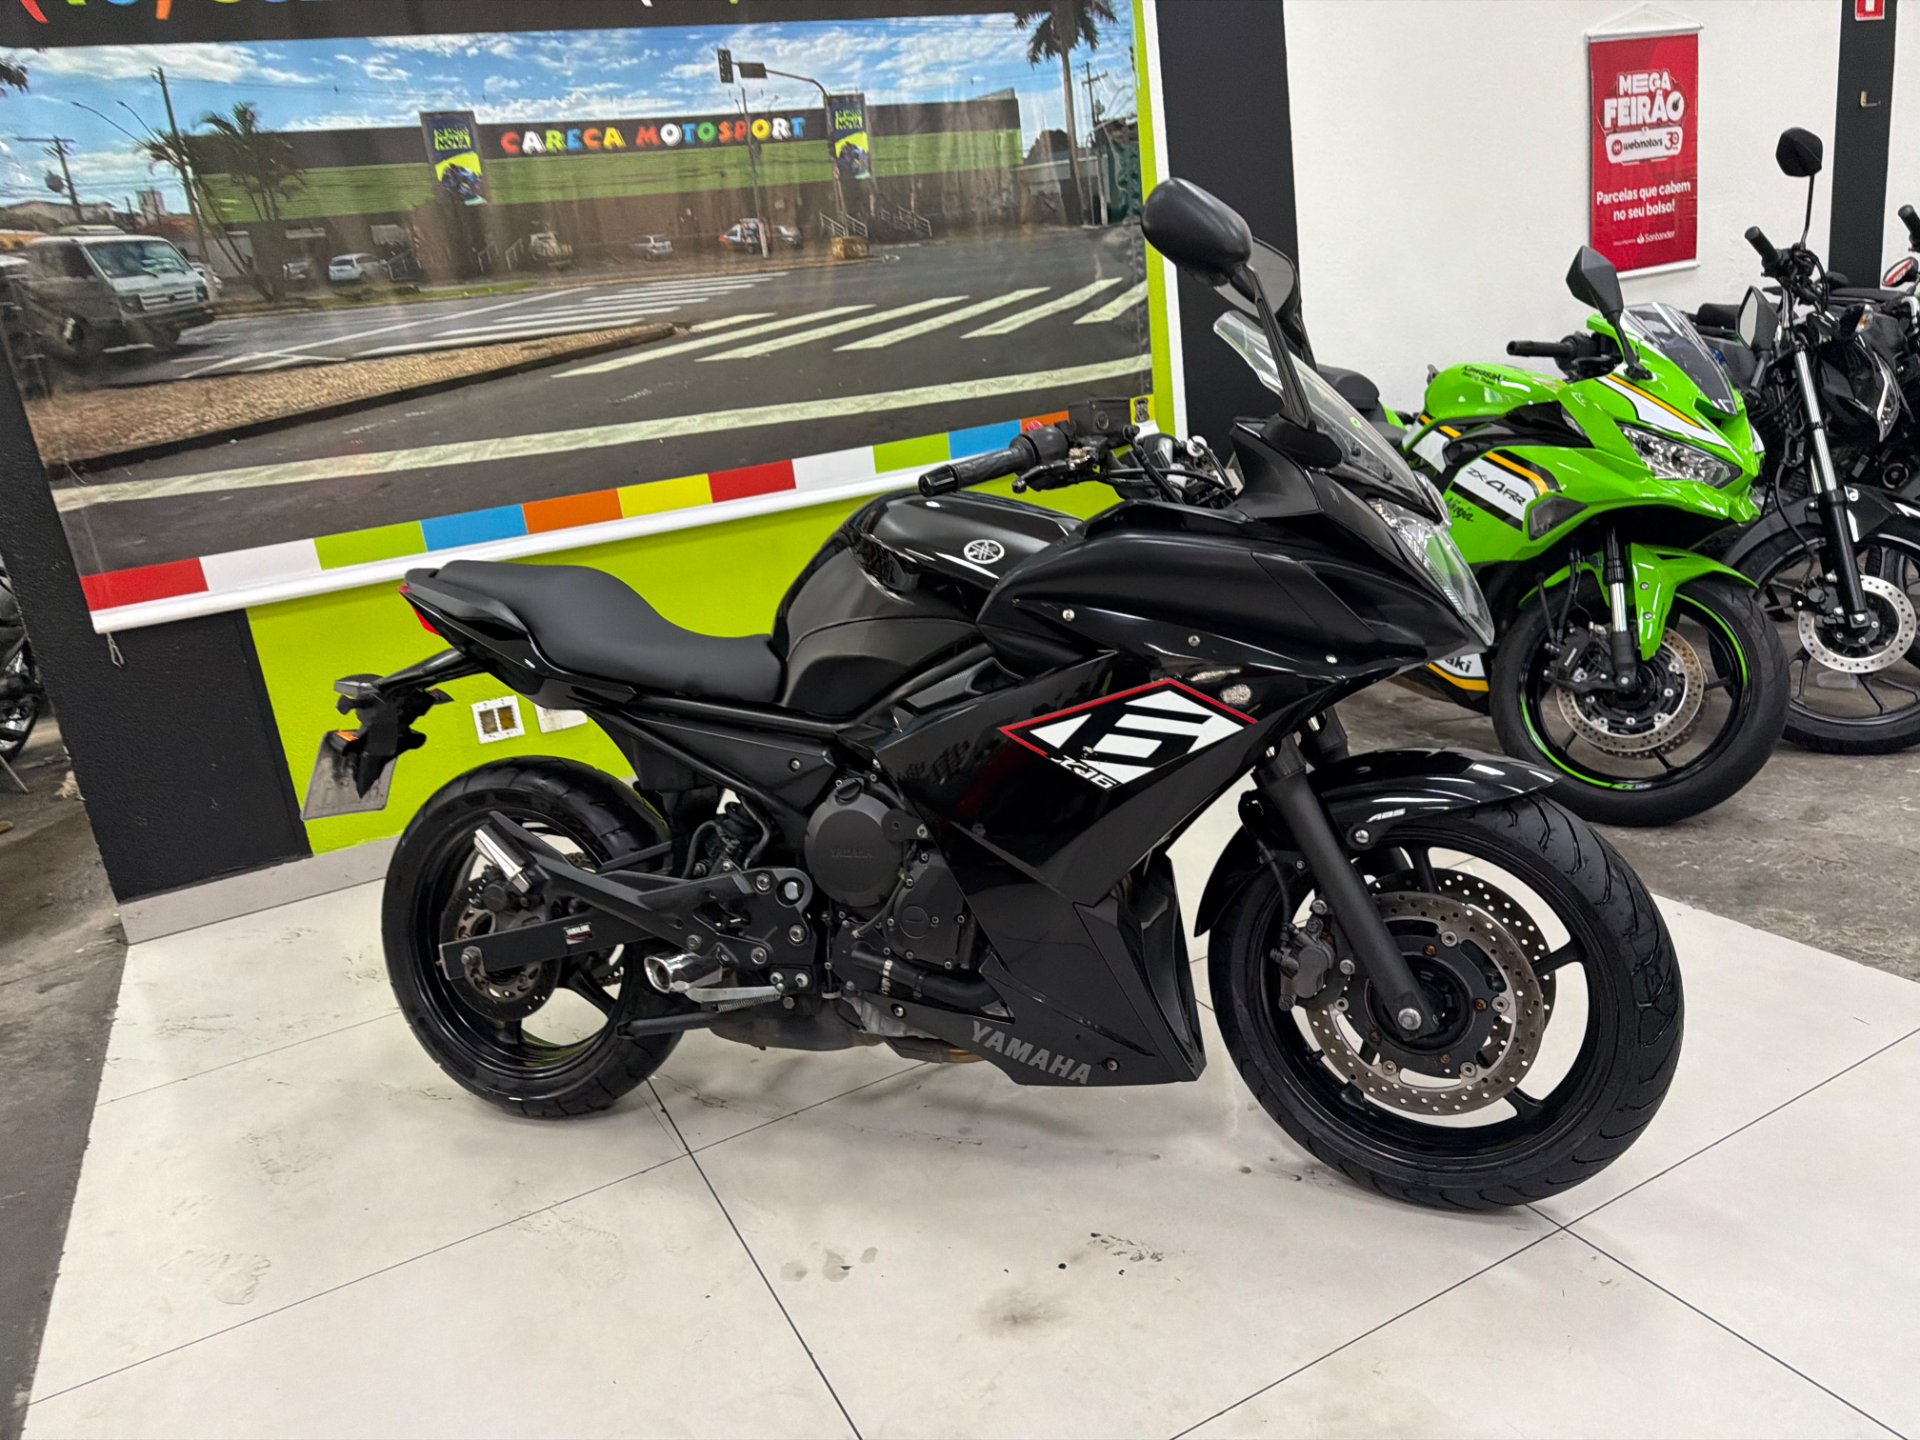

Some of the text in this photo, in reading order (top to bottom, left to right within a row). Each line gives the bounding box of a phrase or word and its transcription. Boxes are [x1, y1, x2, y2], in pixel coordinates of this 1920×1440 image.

[1619, 71, 1671, 96] MEGA
[1603, 88, 1685, 129] FEIRÃO
[501, 117, 806, 154] CARECA MOTOSPORT
[1623, 138, 1663, 151] webmotors
[1596, 180, 1692, 206] Parcelas que cabem
[1613, 198, 1676, 222] no seu bolso!
[1643, 230, 1676, 243] Santander
[971, 1020, 1092, 1085] YAMAHA
